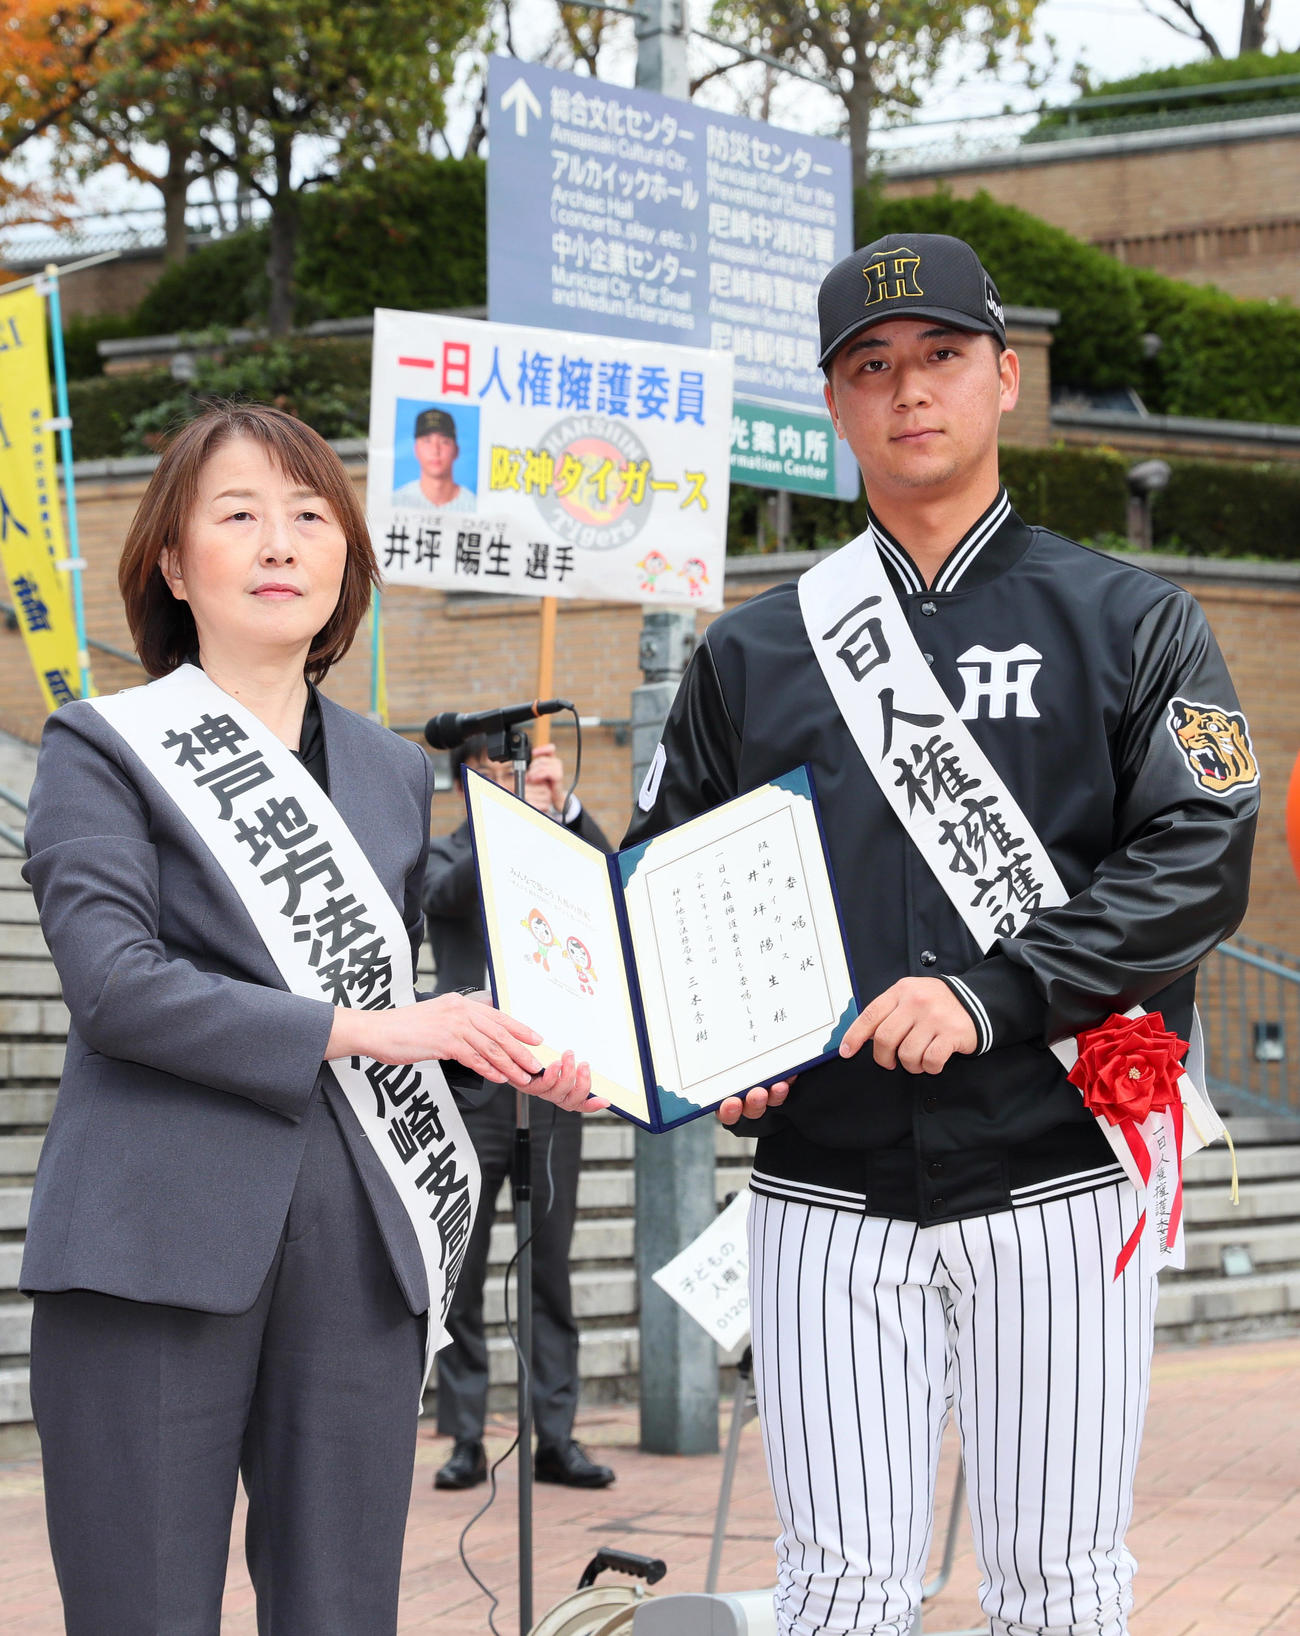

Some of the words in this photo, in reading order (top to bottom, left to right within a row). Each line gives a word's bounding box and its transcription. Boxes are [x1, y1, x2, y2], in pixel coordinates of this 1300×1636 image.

[551, 86, 695, 146] 総合文化センター
[551, 149, 700, 211] アルカイックホール
[706, 124, 833, 179] 防災センター
[551, 229, 697, 284] 中小企業センター
[708, 202, 834, 263] 尼崎中消防署
[709, 261, 819, 316] 尼崎南警察
[397, 341, 706, 426] 一日人権擁護委員
[729, 415, 828, 463] 光案内所
[488, 445, 708, 512] 阪神タイガース
[784, 459, 828, 481] Center
[384, 525, 443, 573] 井坪
[455, 531, 512, 578] 陽生
[525, 542, 574, 582] 選手
[822, 595, 1063, 940] 一日人権擁護
[757, 839, 790, 961] 阪神タイガース
[747, 869, 789, 1024] 井坪陽生様
[161, 712, 471, 1322] 神戸地方法務尼崎支局長
[679, 1241, 737, 1294] 子どもの
[716, 1297, 750, 1330] 0120
